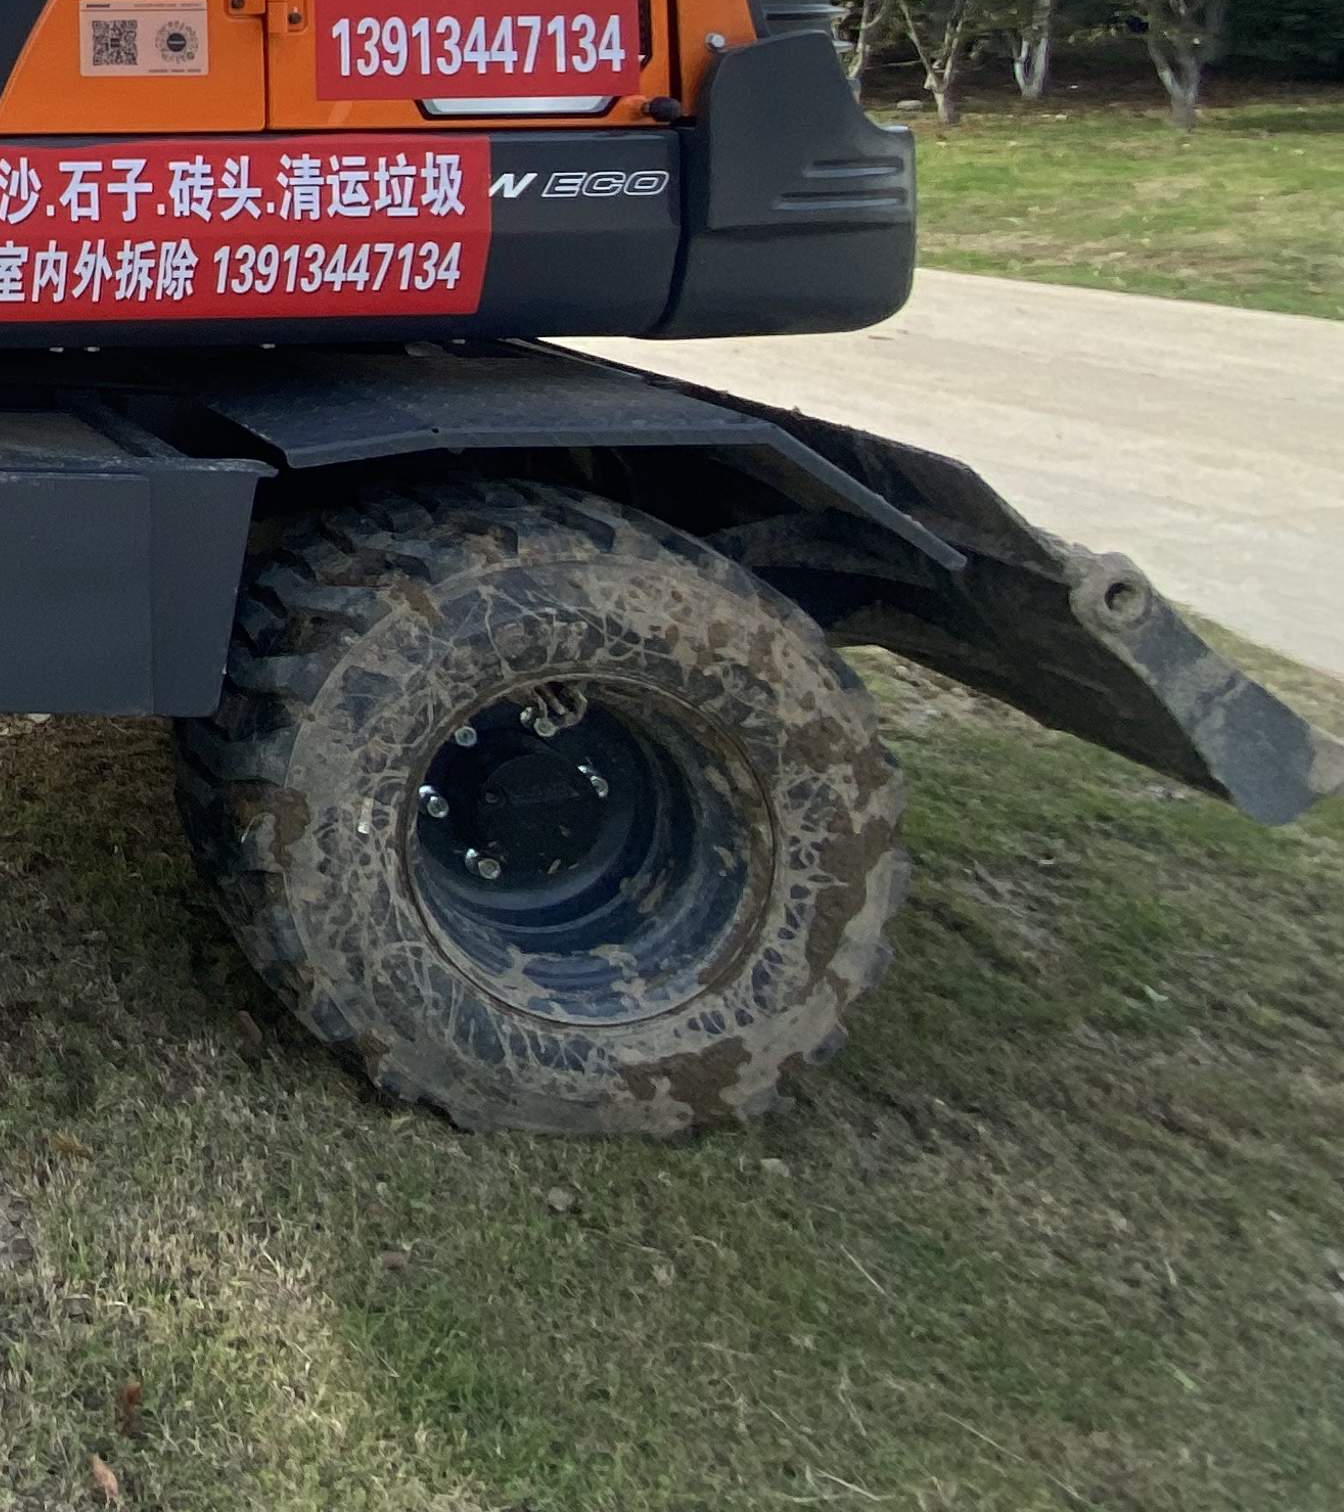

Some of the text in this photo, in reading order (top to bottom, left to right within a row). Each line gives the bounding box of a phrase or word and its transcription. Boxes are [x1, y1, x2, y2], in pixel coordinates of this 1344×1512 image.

[332, 14, 625, 77] 13913447134
[541, 170, 669, 197] ECO
[213, 241, 461, 295] 13913447134
